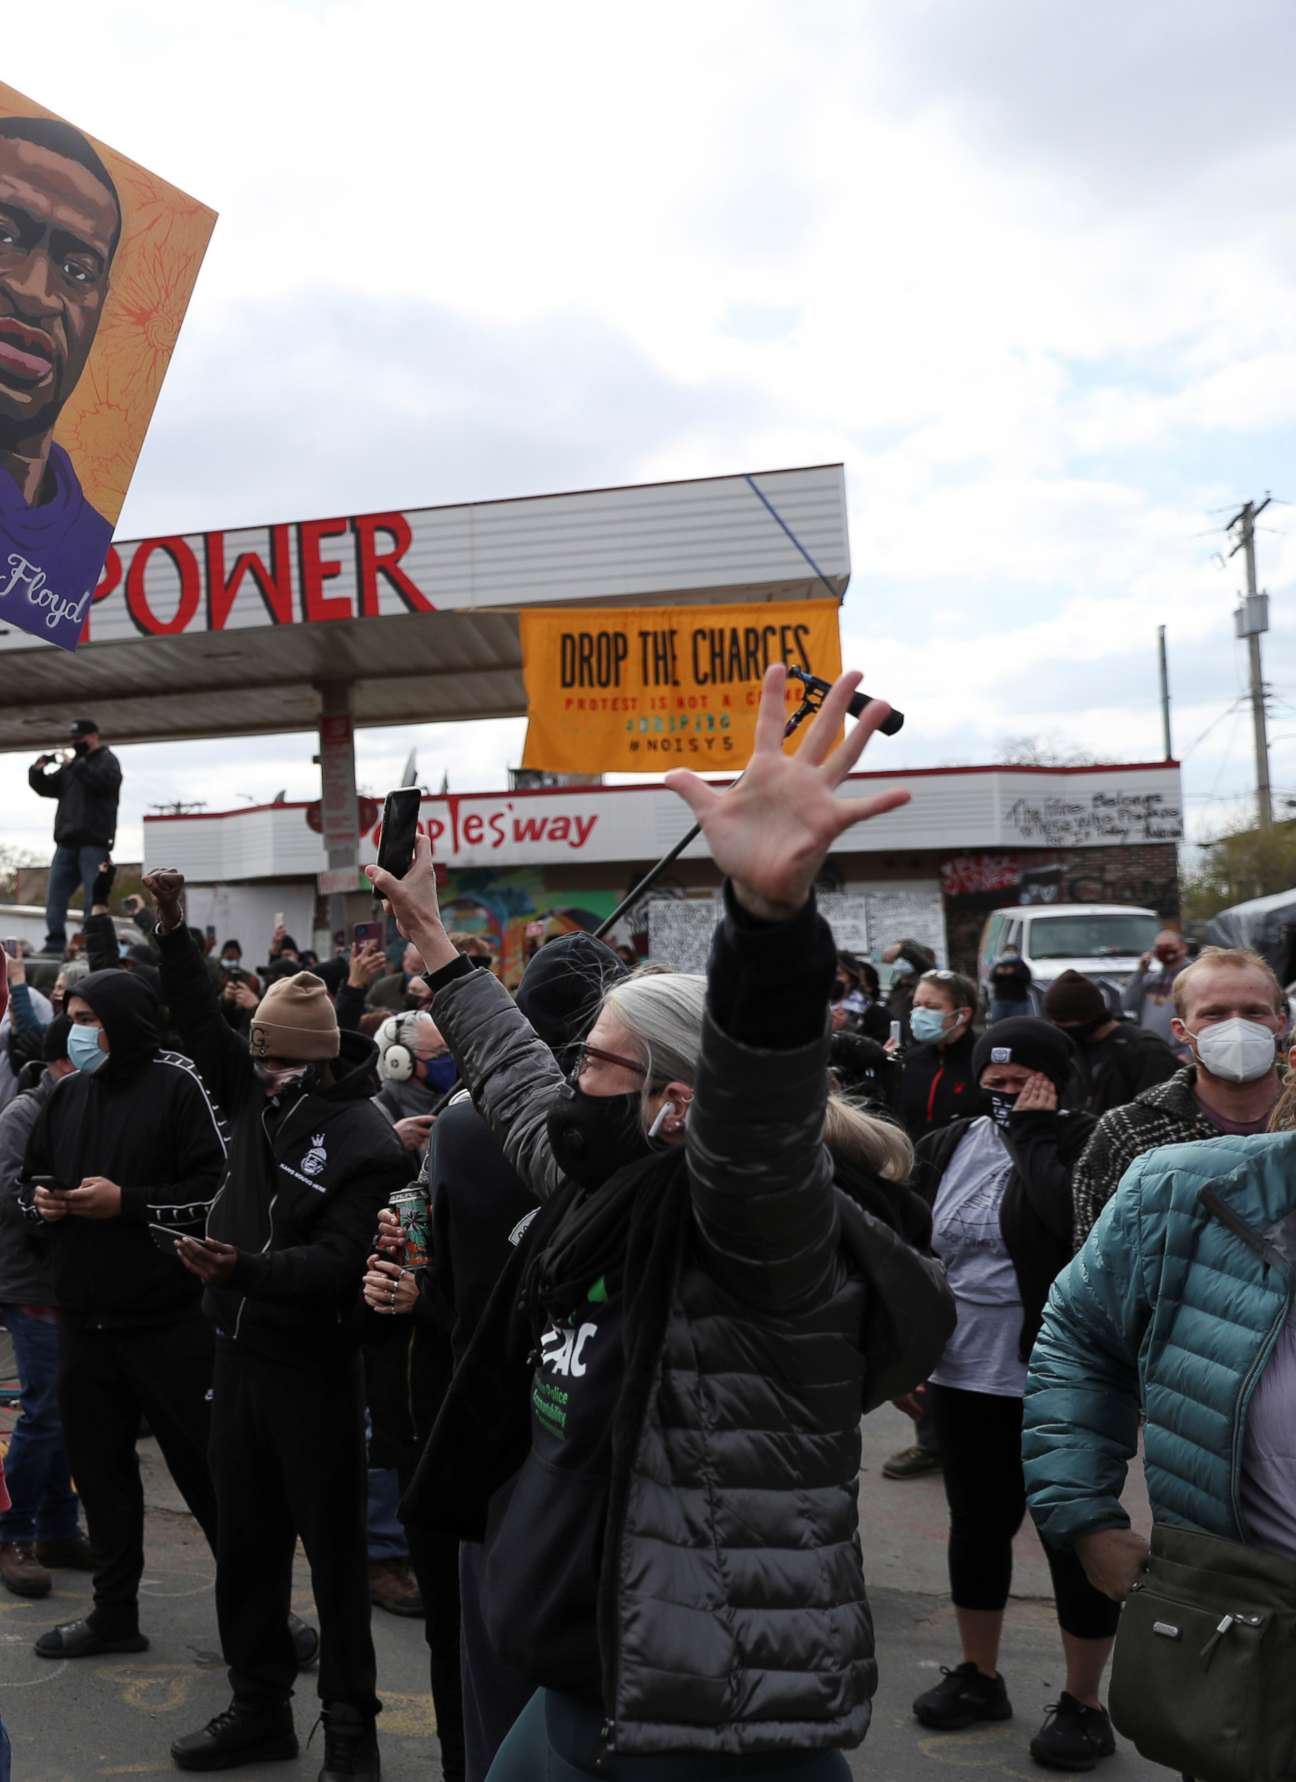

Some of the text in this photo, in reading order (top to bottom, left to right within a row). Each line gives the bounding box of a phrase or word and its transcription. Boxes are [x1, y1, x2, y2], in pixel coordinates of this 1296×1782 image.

[560, 632, 629, 690] DROP
[639, 628, 681, 688] THE
[564, 696, 638, 712] PROTEST
[650, 695, 669, 710] IS
[677, 695, 709, 710] NOT
[722, 693, 733, 708] A
